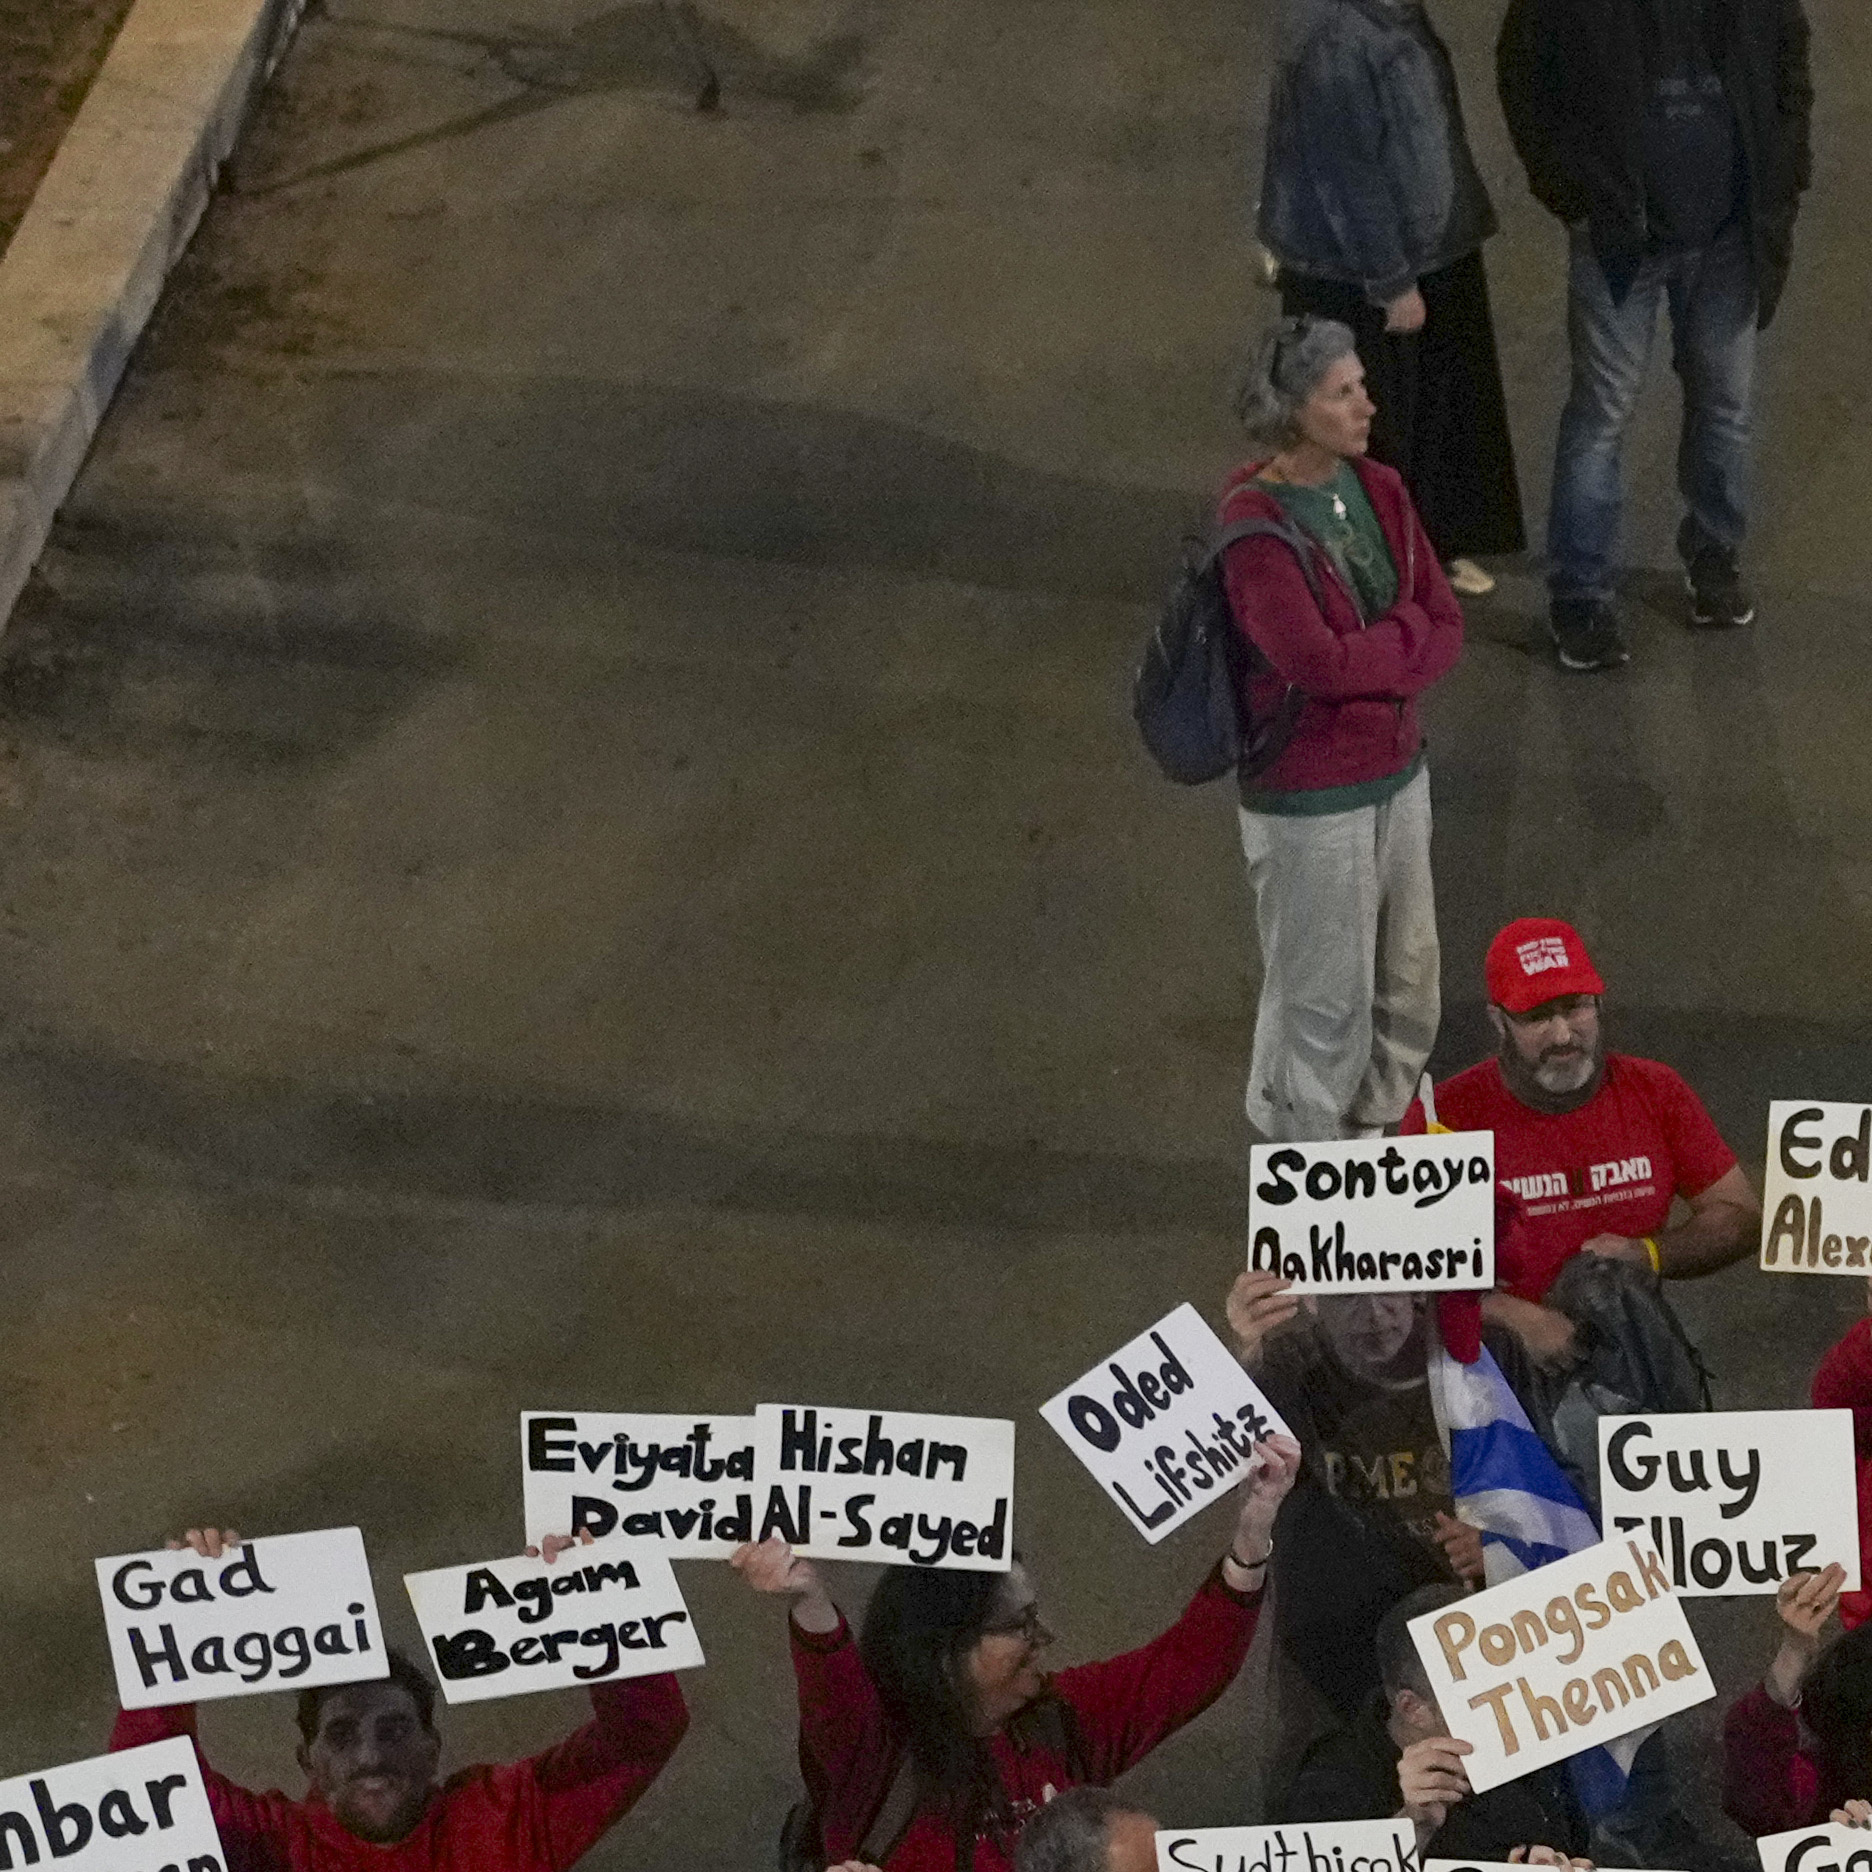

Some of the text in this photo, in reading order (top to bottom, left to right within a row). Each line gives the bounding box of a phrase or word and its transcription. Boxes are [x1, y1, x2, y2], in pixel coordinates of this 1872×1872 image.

[1254, 1146, 1492, 1212] Sontaya
[1065, 1331, 1196, 1456] Oded
[779, 1409, 969, 1485] Hisham
[1607, 1420, 1763, 1520] Guy
[112, 1545, 276, 1612] Gad
[461, 1557, 642, 1626] Agam
[1432, 1540, 1673, 1683] Pongsak
[128, 1601, 373, 1691] Haggai
[431, 1609, 688, 1683] Berger
[1467, 1630, 1699, 1760] Thenna
